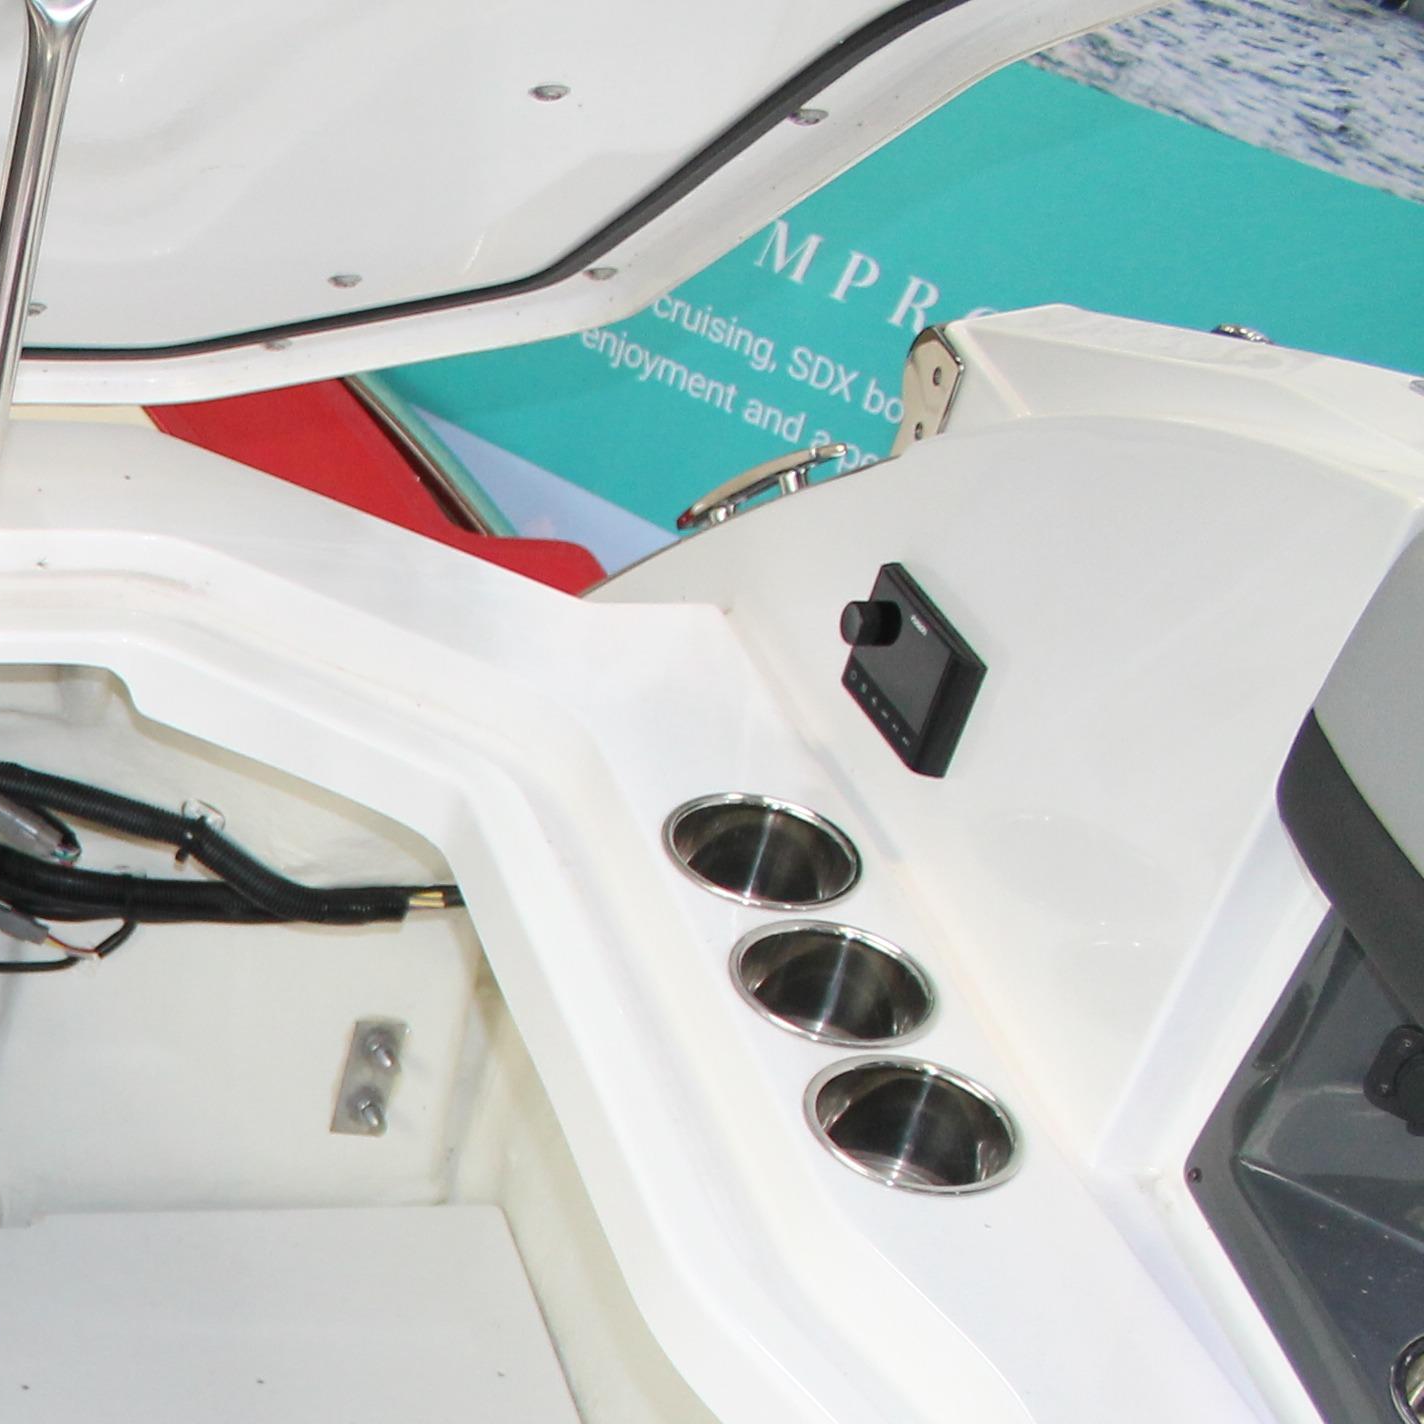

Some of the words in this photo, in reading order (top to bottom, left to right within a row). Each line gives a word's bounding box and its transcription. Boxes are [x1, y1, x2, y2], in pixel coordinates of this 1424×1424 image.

[582, 325, 738, 414] enjoyment
[743, 397, 806, 443] and
[653, 293, 777, 373] cruising,
[787, 346, 862, 402] SDX
